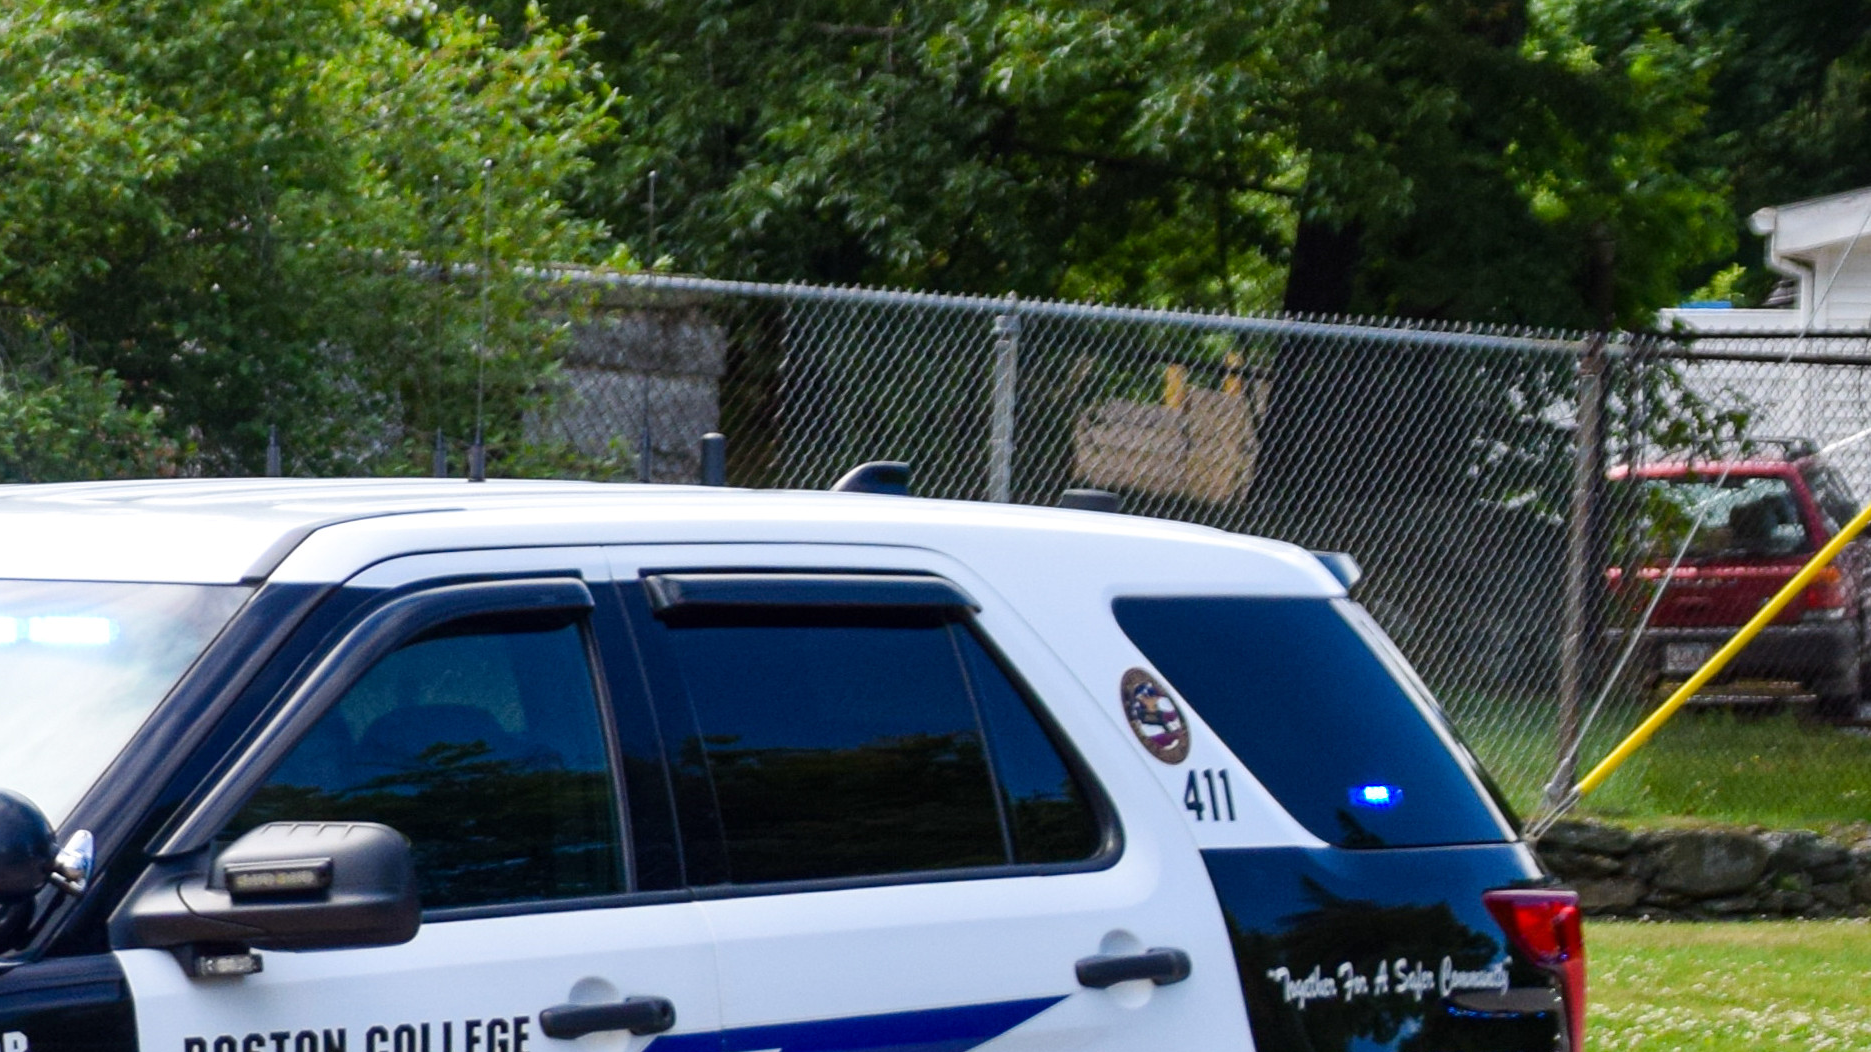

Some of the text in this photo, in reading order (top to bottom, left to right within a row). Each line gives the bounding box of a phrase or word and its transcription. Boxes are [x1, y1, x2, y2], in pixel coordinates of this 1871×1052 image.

[1184, 769, 1236, 821] 411
[1337, 961, 1369, 1001] For
[1373, 959, 1390, 997] A
[1393, 957, 1436, 1001] Safer
